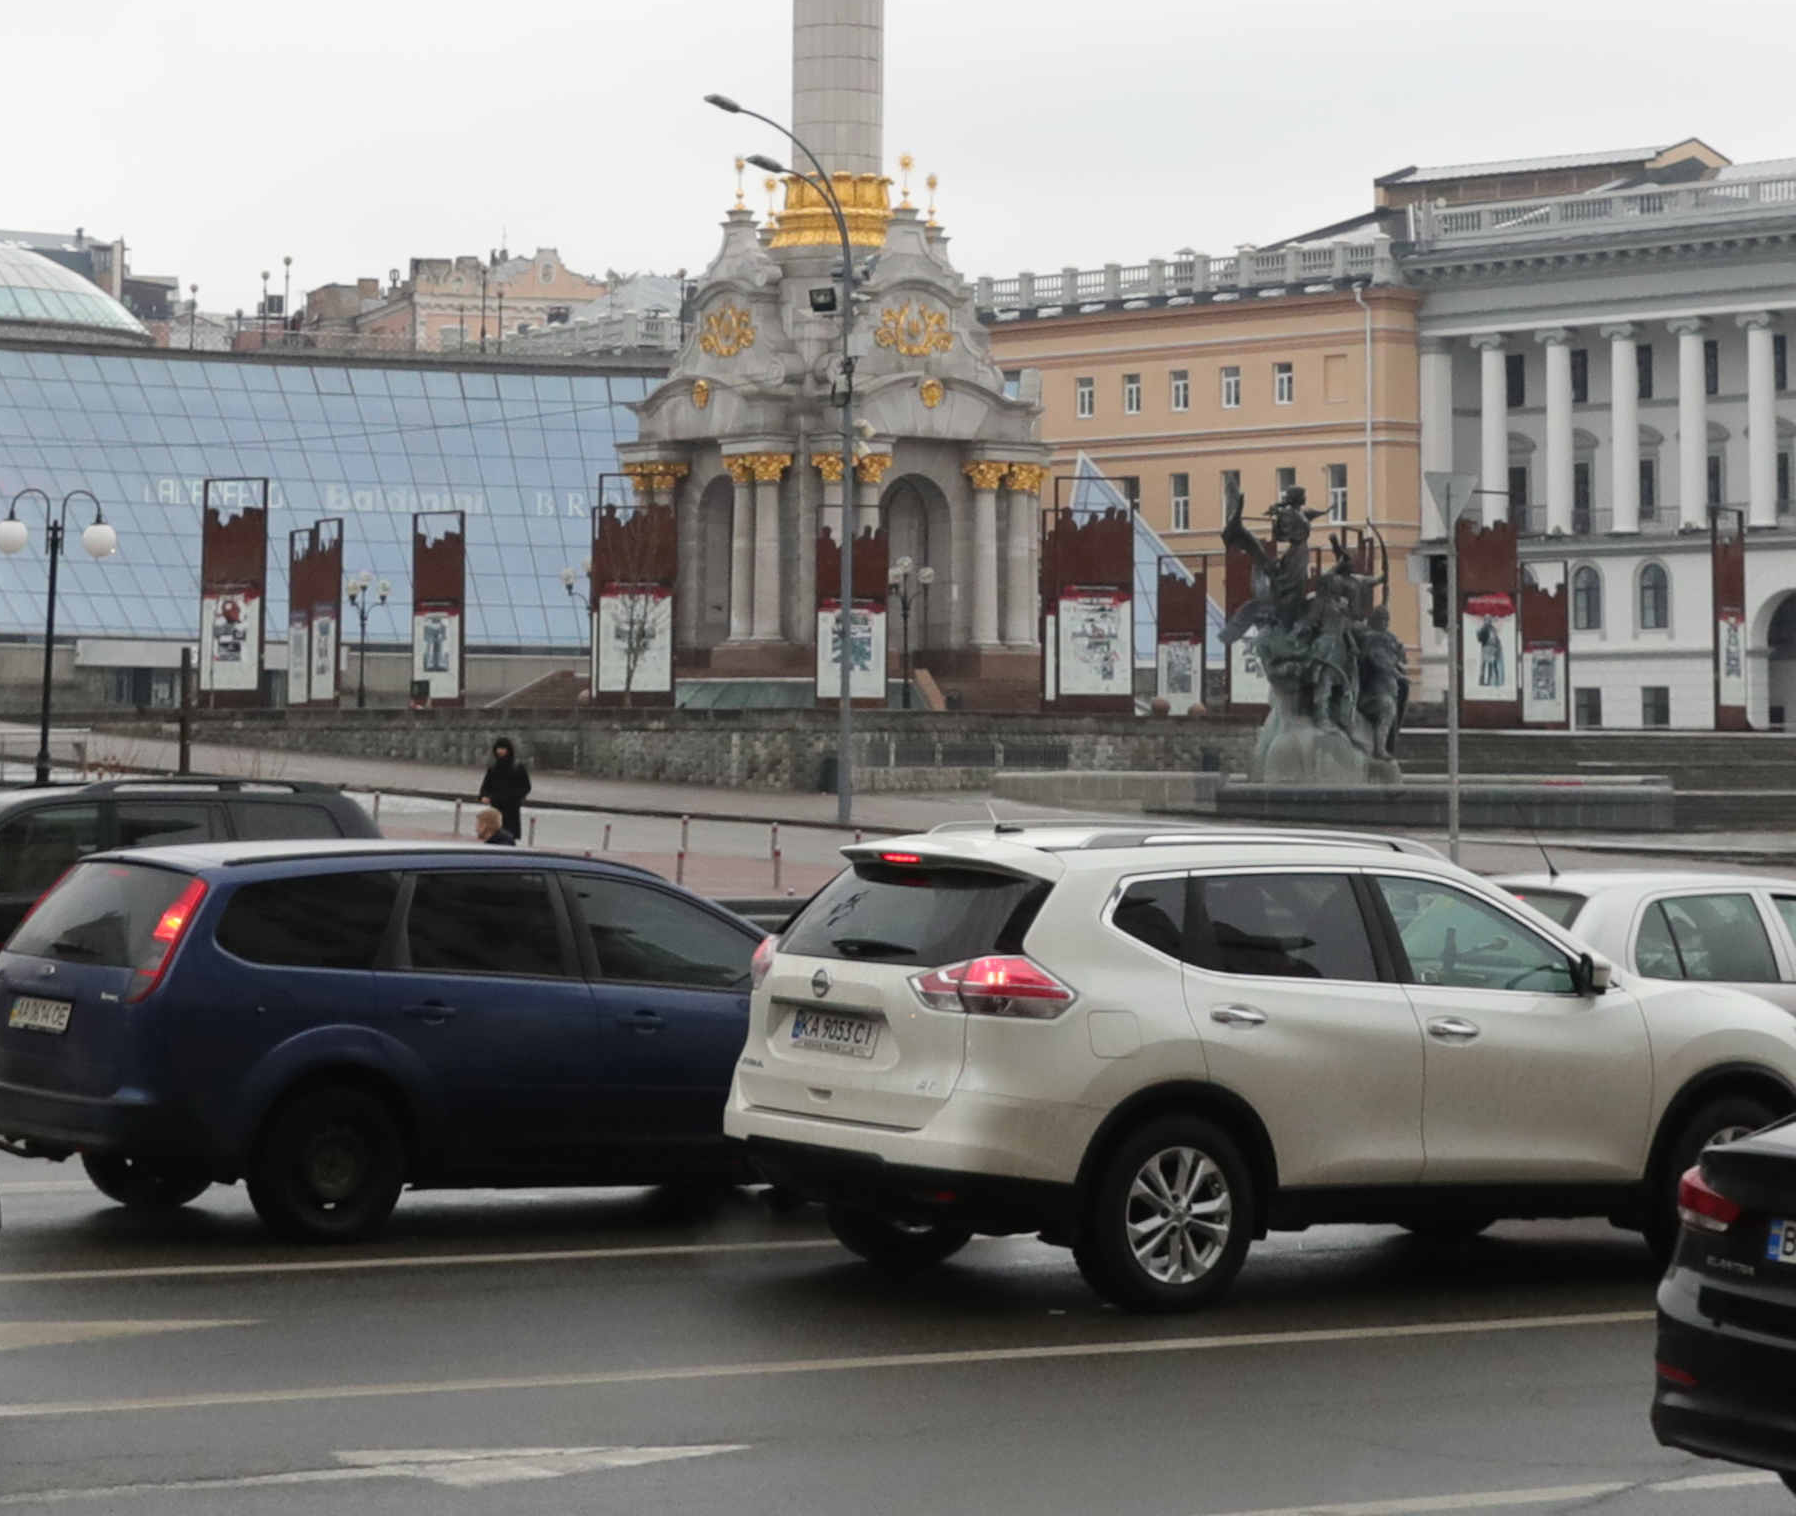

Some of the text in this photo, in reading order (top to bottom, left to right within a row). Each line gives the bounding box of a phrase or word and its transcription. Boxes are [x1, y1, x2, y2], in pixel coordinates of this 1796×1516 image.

[803, 1015, 873, 1045] KA 9053 CI
